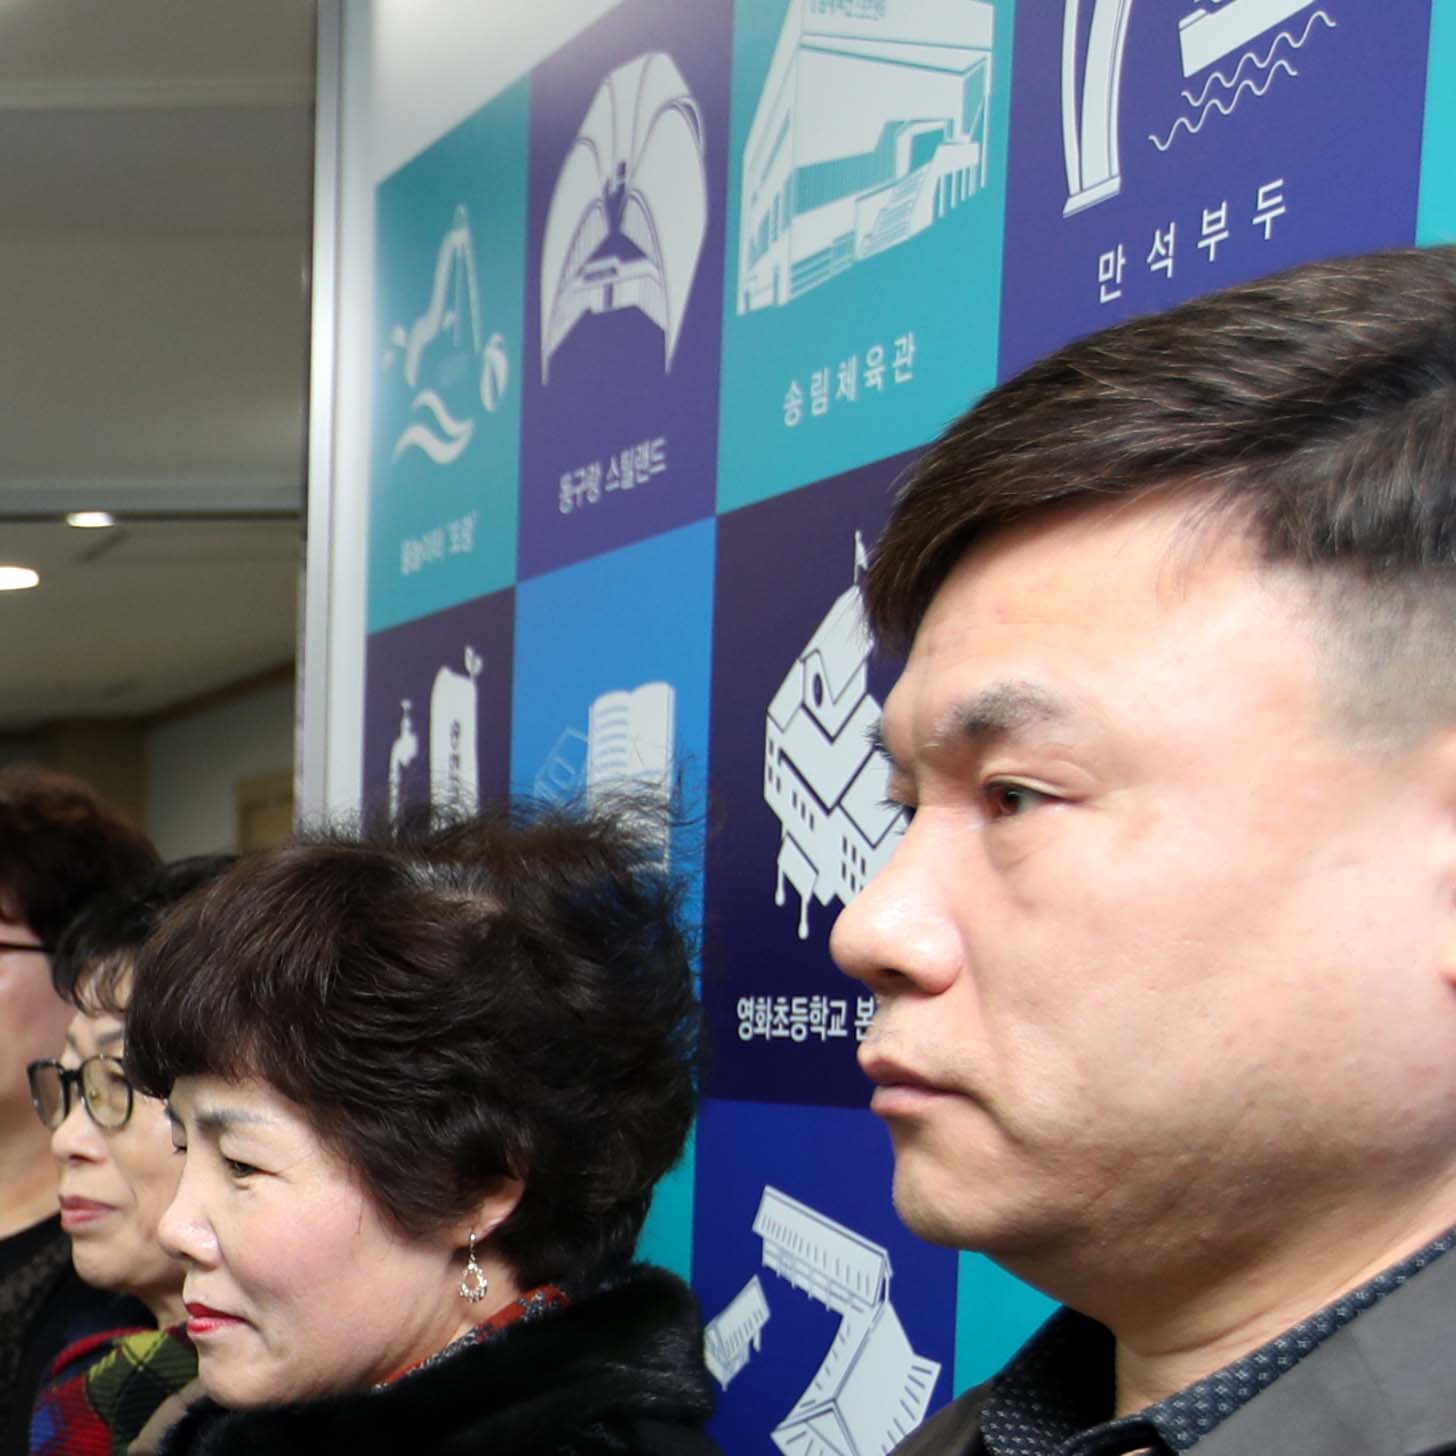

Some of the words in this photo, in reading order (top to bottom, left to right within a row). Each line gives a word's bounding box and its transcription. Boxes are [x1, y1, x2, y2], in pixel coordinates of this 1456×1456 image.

[783, 330, 916, 428] 송림체육관
[605, 437, 667, 490] 스틸랜드
[737, 994, 848, 1042] 영화초등학교
